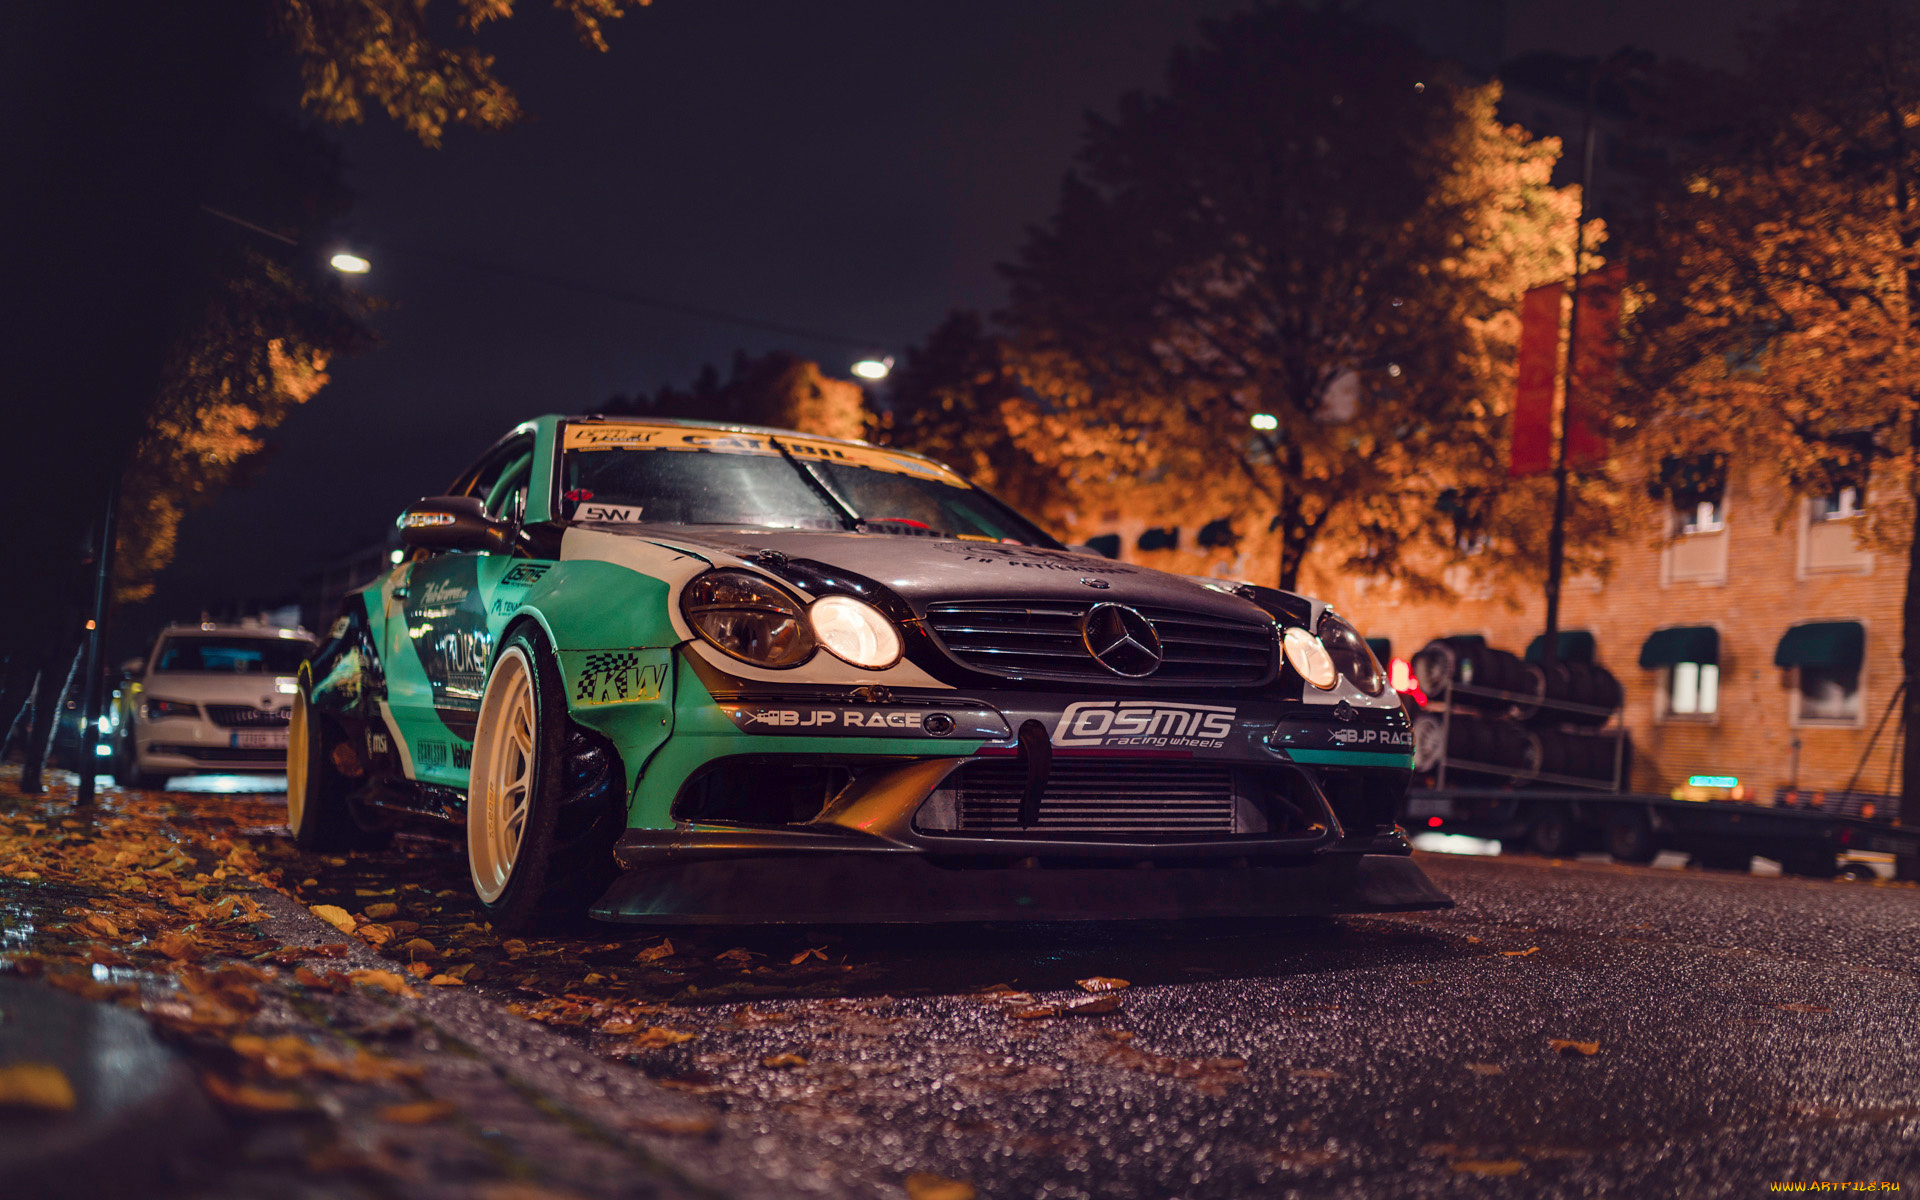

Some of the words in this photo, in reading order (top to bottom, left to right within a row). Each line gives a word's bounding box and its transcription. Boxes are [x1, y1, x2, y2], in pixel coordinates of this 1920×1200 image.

[591, 664, 668, 705] KW
[780, 710, 836, 726] BJP
[843, 711, 922, 728] RACE
[1105, 736, 1168, 747] racing
[1169, 737, 1225, 749] wheels
[1347, 729, 1377, 744] BJP
